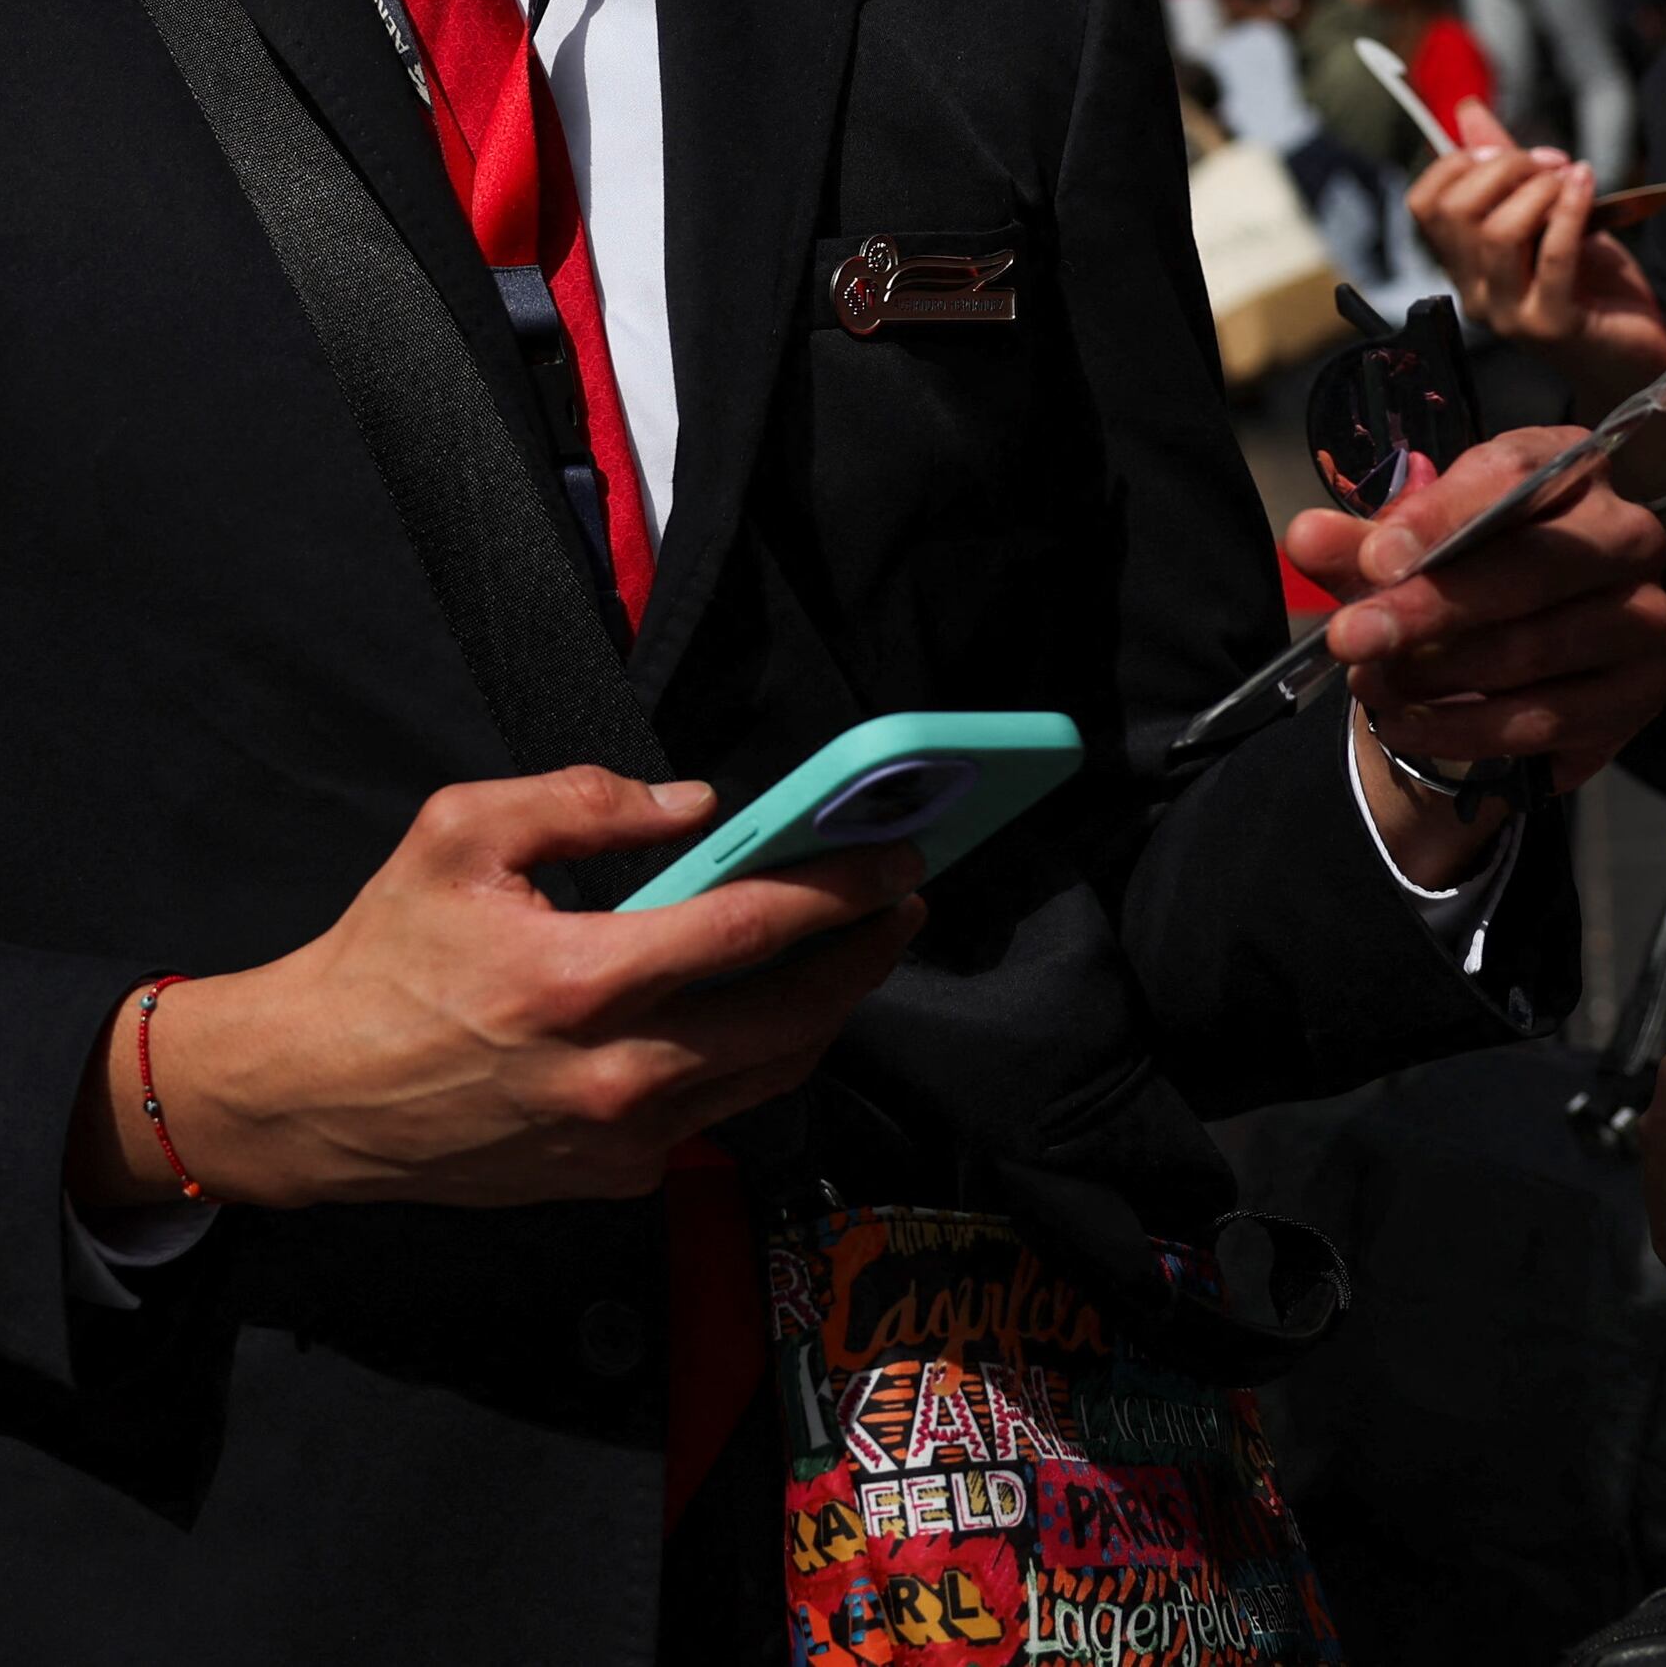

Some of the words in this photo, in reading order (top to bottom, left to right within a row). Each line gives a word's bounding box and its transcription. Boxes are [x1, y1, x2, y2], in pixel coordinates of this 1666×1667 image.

[836, 1359, 1090, 1473] KARL
[860, 1469, 1027, 1539] FELD
[1023, 1556, 1247, 1667] Lagerfeld
